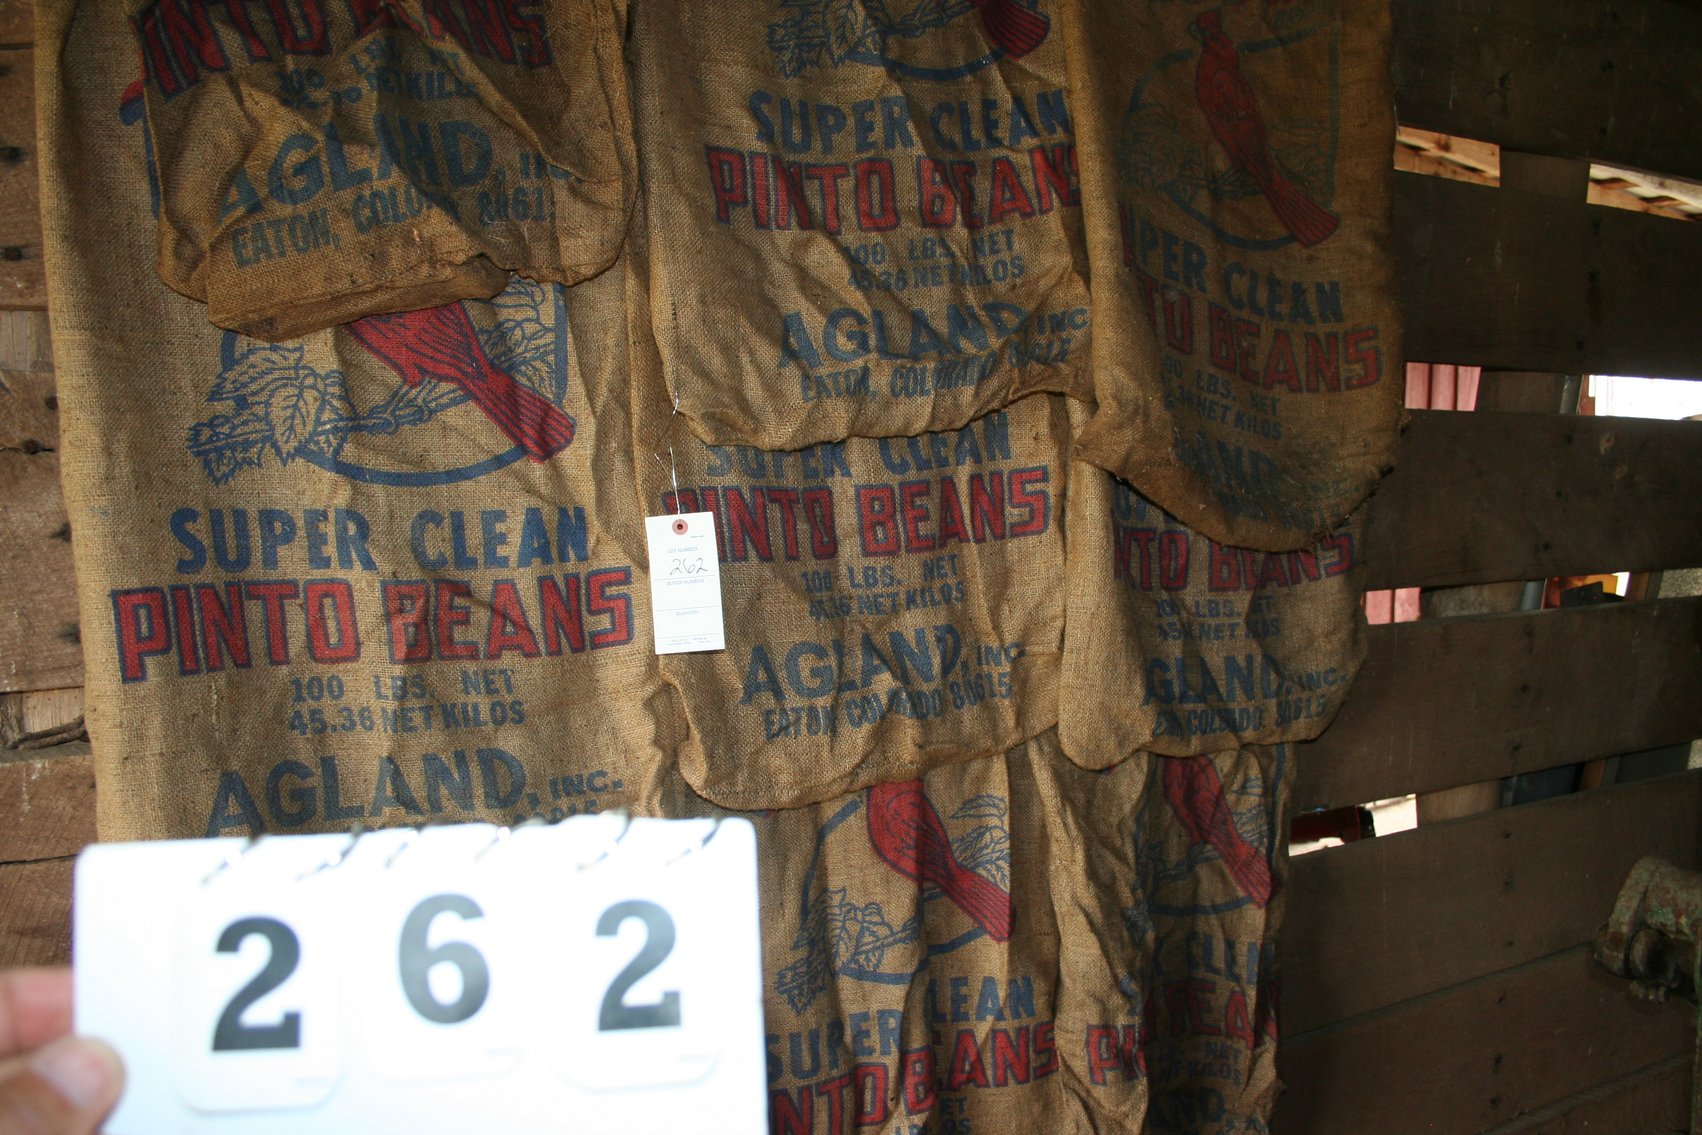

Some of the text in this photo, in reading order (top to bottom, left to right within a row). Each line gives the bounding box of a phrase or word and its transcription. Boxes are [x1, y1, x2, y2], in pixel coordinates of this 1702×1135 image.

[748, 88, 1072, 155] SUPER CLEAN
[704, 143, 902, 236] PINTO
[1223, 261, 1345, 325] CLEAN
[1208, 302, 1384, 392] BEANS
[169, 506, 589, 574] SUPER CLEAN
[854, 465, 1051, 558] BEANS
[669, 557, 709, 576] 262
[922, 553, 959, 583] NET
[111, 565, 635, 685] PINTO BEANS
[857, 592, 899, 616] NET
[288, 669, 516, 703] 100 LBS. NET
[288, 700, 526, 736] 45.36 NET KILOS
[549, 768, 624, 800] INC.
[765, 1008, 902, 1083] SUPER
